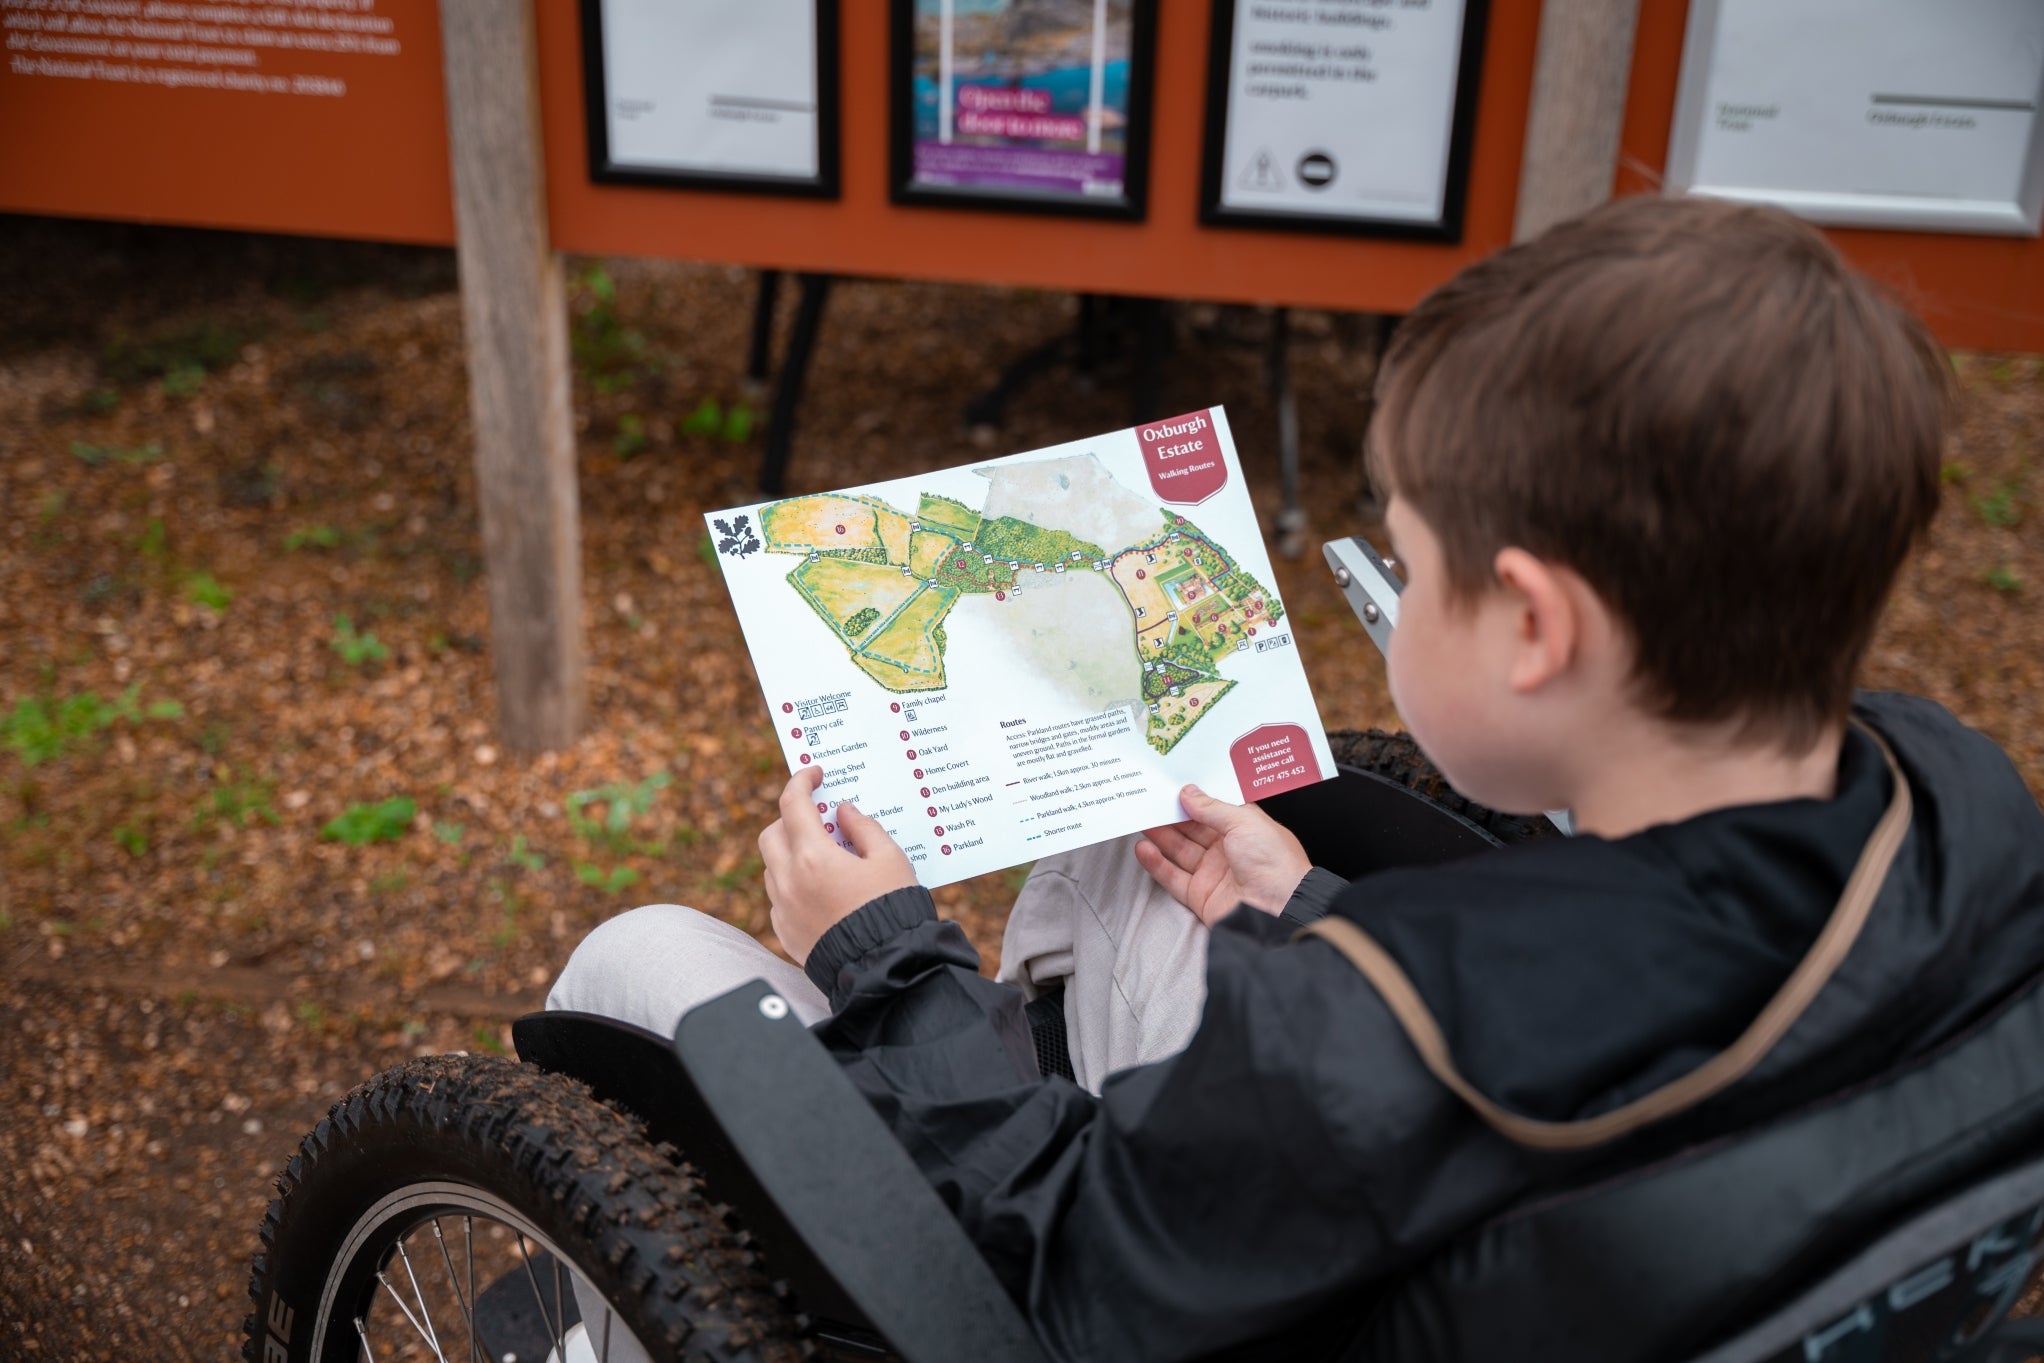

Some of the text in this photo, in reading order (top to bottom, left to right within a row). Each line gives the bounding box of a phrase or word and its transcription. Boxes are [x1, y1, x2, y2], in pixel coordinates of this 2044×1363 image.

[1143, 415, 1207, 442] Oxburgh
[1157, 440, 1204, 460] Estate
[1158, 461, 1216, 480] Walking Routes
[794, 698, 818, 708] Visitor
[819, 691, 851, 703] Welcome
[902, 698, 923, 709] Family
[924, 694, 946, 705] chapel
[803, 722, 828, 734] Pantry
[912, 725, 948, 737] Wilderness
[999, 717, 1027, 729] Routes
[1027, 726, 1052, 737] Parkland
[1052, 721, 1071, 731] routes
[1070, 718, 1084, 728] have
[1084, 712, 1107, 725] grassed
[1107, 708, 1126, 719] paths,
[1009, 741, 1030, 750] narrow
[1029, 735, 1051, 747] bridges
[1051, 732, 1062, 742] and
[1079, 725, 1100, 735] muddy
[1100, 721, 1116, 729] areas
[1116, 717, 1128, 726] and
[1012, 749, 1034, 759] uneven
[1055, 740, 1072, 749] Paths
[1072, 738, 1079, 746] in
[1078, 735, 1088, 744] the
[1088, 731, 1108, 741] formal
[1107, 725, 1131, 737] gardens
[812, 748, 841, 760] Kitchen
[841, 741, 868, 753] Garden
[918, 747, 933, 757] Oak
[932, 743, 949, 753] Yard
[1247, 735, 1290, 755] If you need
[1016, 760, 1026, 768] are
[1026, 755, 1046, 766] mostly
[1045, 753, 1055, 762] flat
[1056, 750, 1067, 759] and
[1252, 747, 1292, 764] assistance
[824, 761, 866, 778] otting Shed
[925, 765, 946, 776] Home
[946, 760, 970, 770] Covert
[1022, 776, 1038, 785] River
[1091, 761, 1099, 769] 30
[1099, 757, 1121, 767] minutes
[1255, 755, 1295, 775] please call
[823, 775, 859, 789] bookshop
[931, 786, 947, 795] Den
[946, 778, 975, 791] building
[975, 775, 990, 784] area
[1253, 765, 1306, 788] 07747 475 452
[1030, 789, 1060, 802] Woodland
[1121, 770, 1143, 780] minutes
[879, 806, 904, 817] Border
[939, 805, 950, 814] My
[950, 800, 972, 811] Lady's
[972, 793, 994, 805] Wood
[1036, 807, 1063, 820] Parkland
[1125, 787, 1147, 797] minutes
[946, 821, 966, 832] Wash
[965, 819, 976, 827] Pit
[1043, 822, 1083, 837] Shorter route
[953, 836, 984, 851] Parkland
